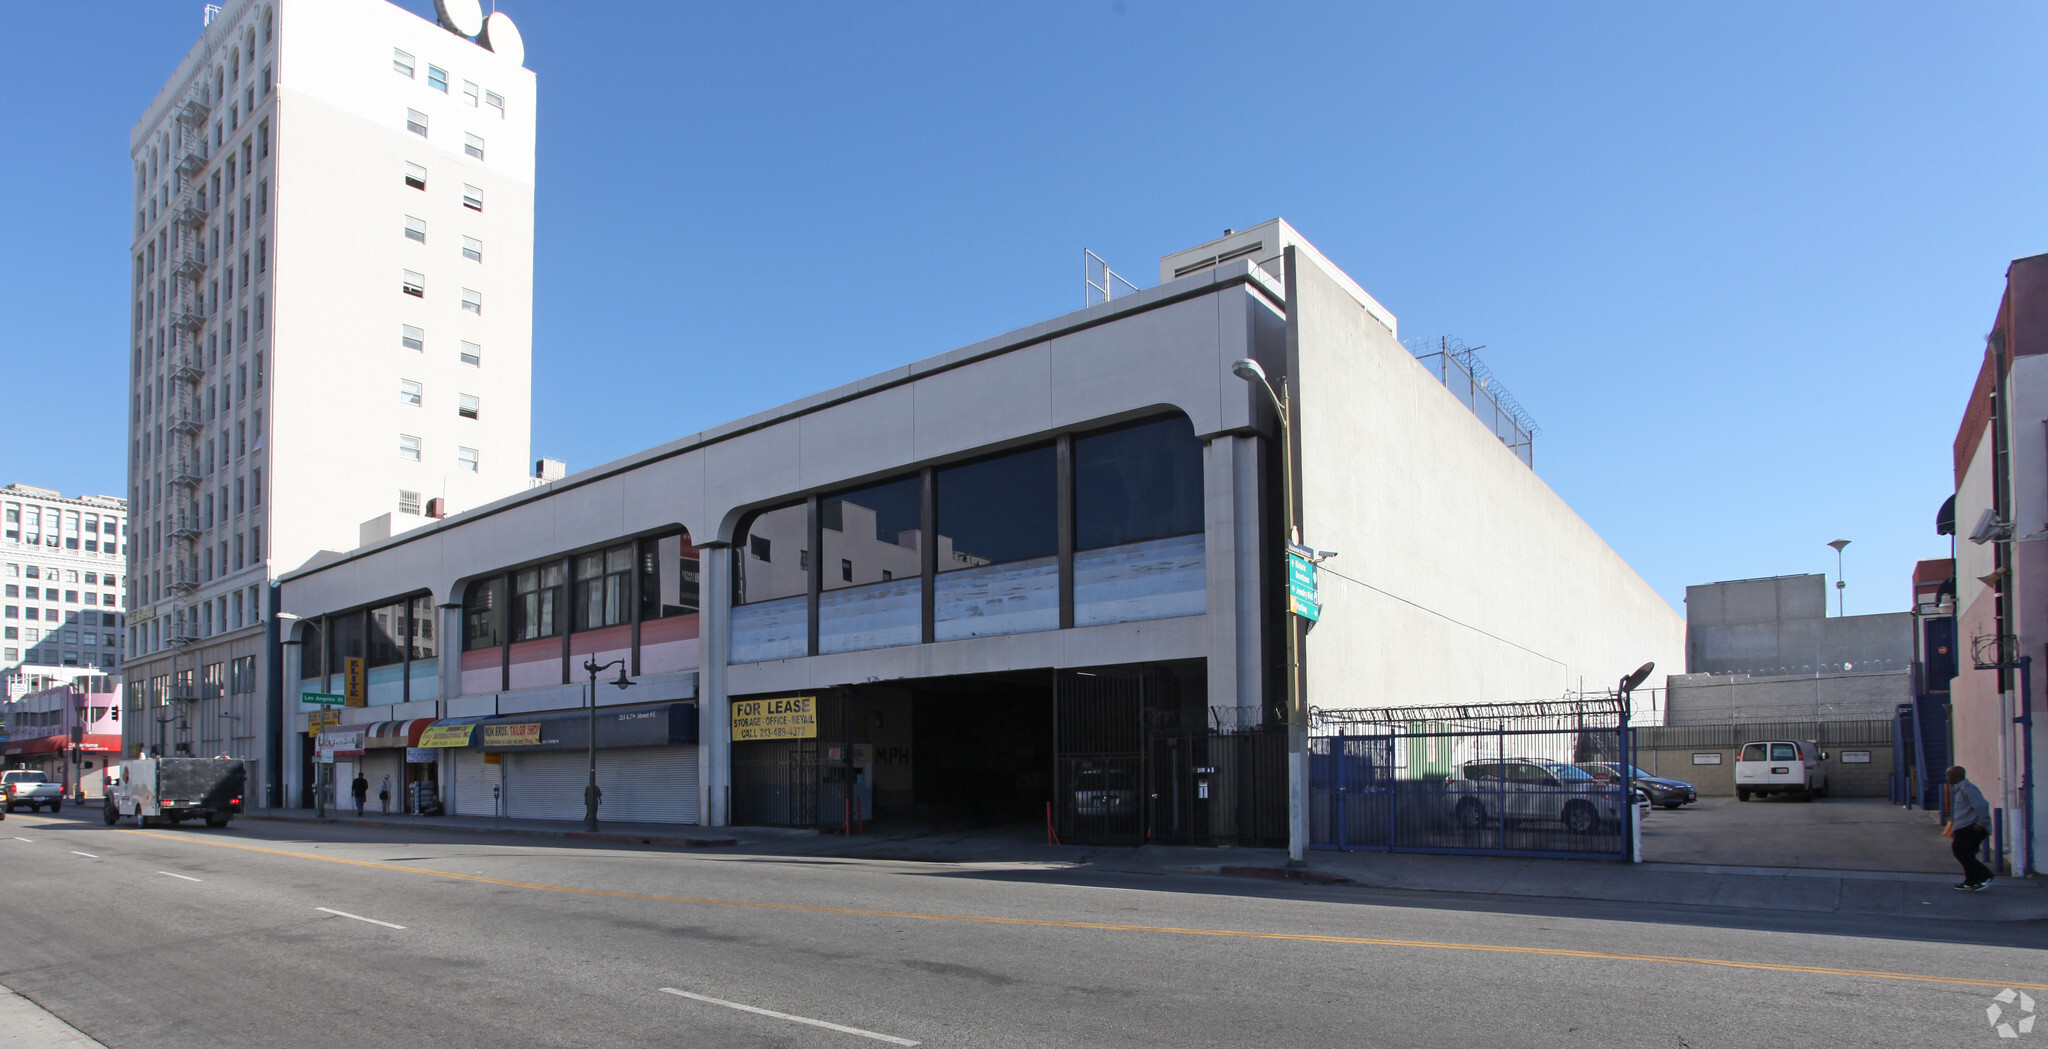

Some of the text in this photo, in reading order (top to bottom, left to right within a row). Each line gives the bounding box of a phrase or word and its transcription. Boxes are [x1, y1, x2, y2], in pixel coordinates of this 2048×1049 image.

[349, 660, 359, 697] ELITE
[315, 695, 336, 703] Angeles
[737, 699, 810, 717] FOR LEASE
[733, 714, 815, 728] STORAGE OFFICE RETAIL
[510, 725, 526, 736] TAILOR
[527, 724, 540, 736] SHOP
[741, 728, 758, 738] CALL
[875, 747, 909, 765] MPH
